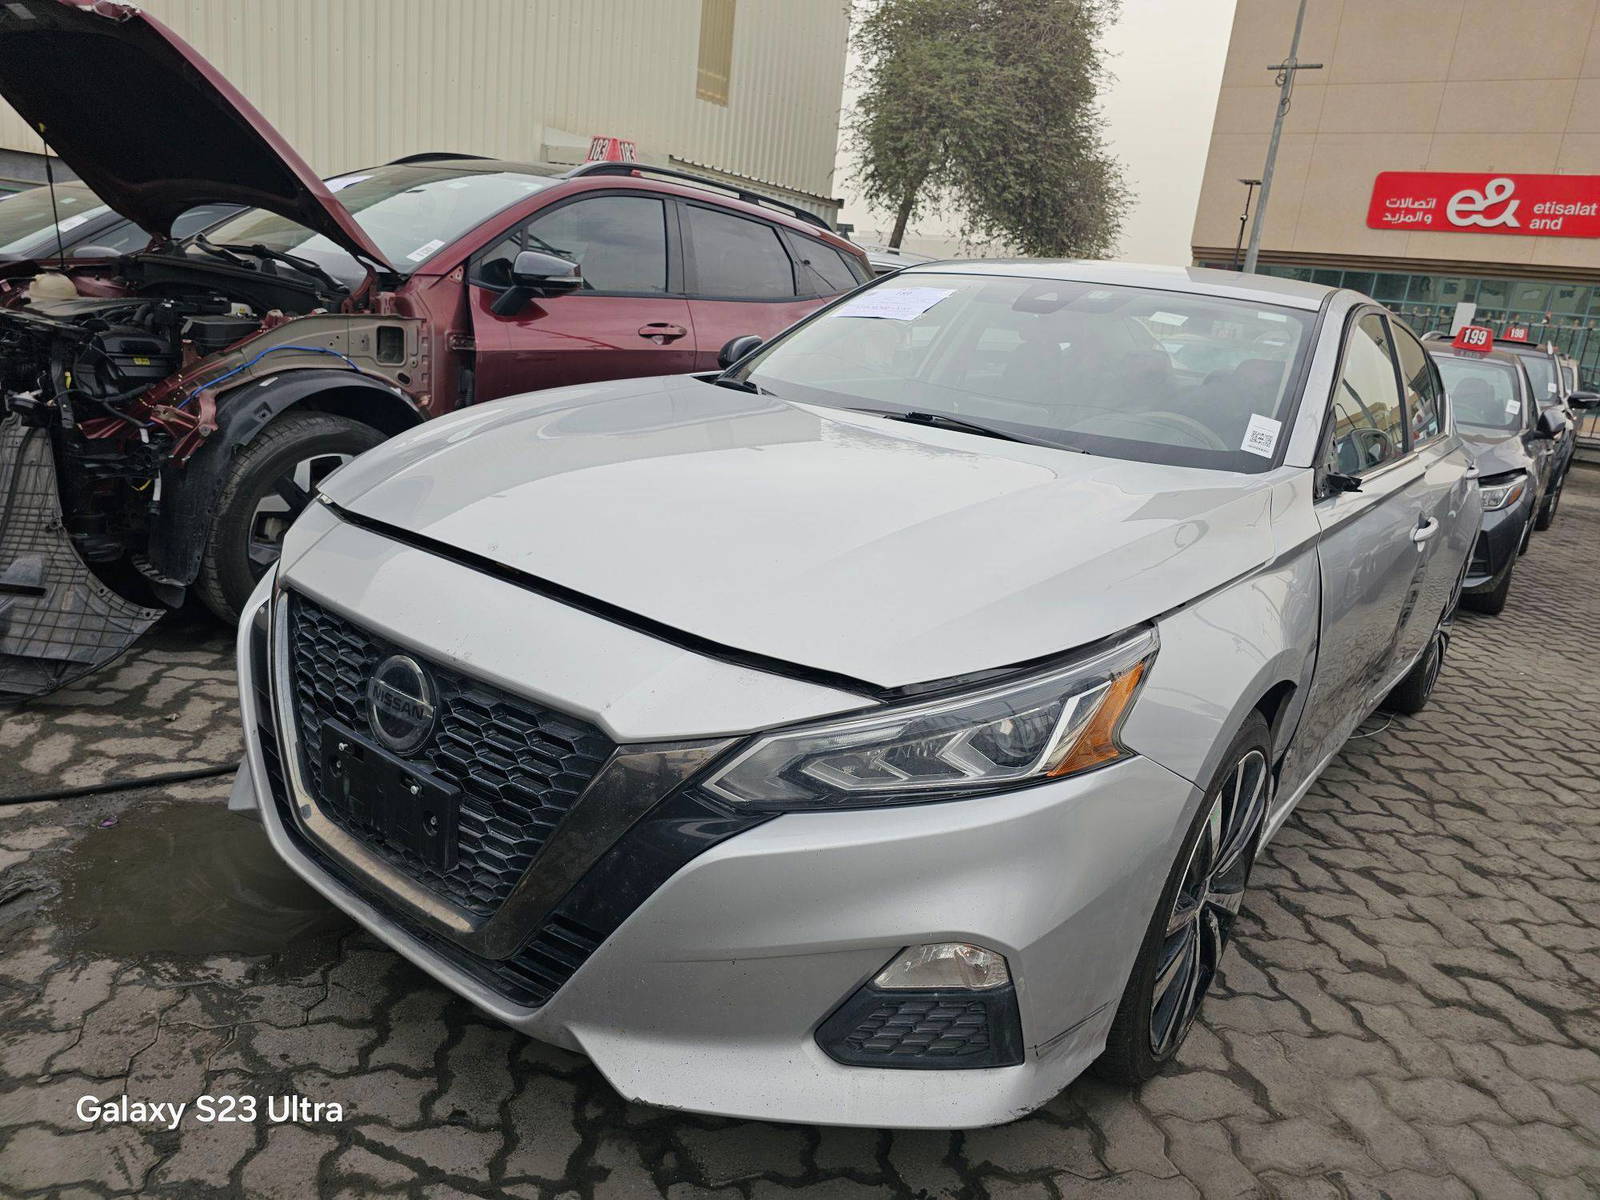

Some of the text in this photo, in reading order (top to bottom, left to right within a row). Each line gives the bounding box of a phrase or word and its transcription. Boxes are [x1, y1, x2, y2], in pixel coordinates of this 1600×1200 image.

[1385, 197, 1437, 210] اتصالات
[1532, 201, 1598, 217] etisalat
[1529, 217, 1563, 231] and
[1463, 328, 1487, 345] 199
[373, 686, 424, 719] NISSAN
